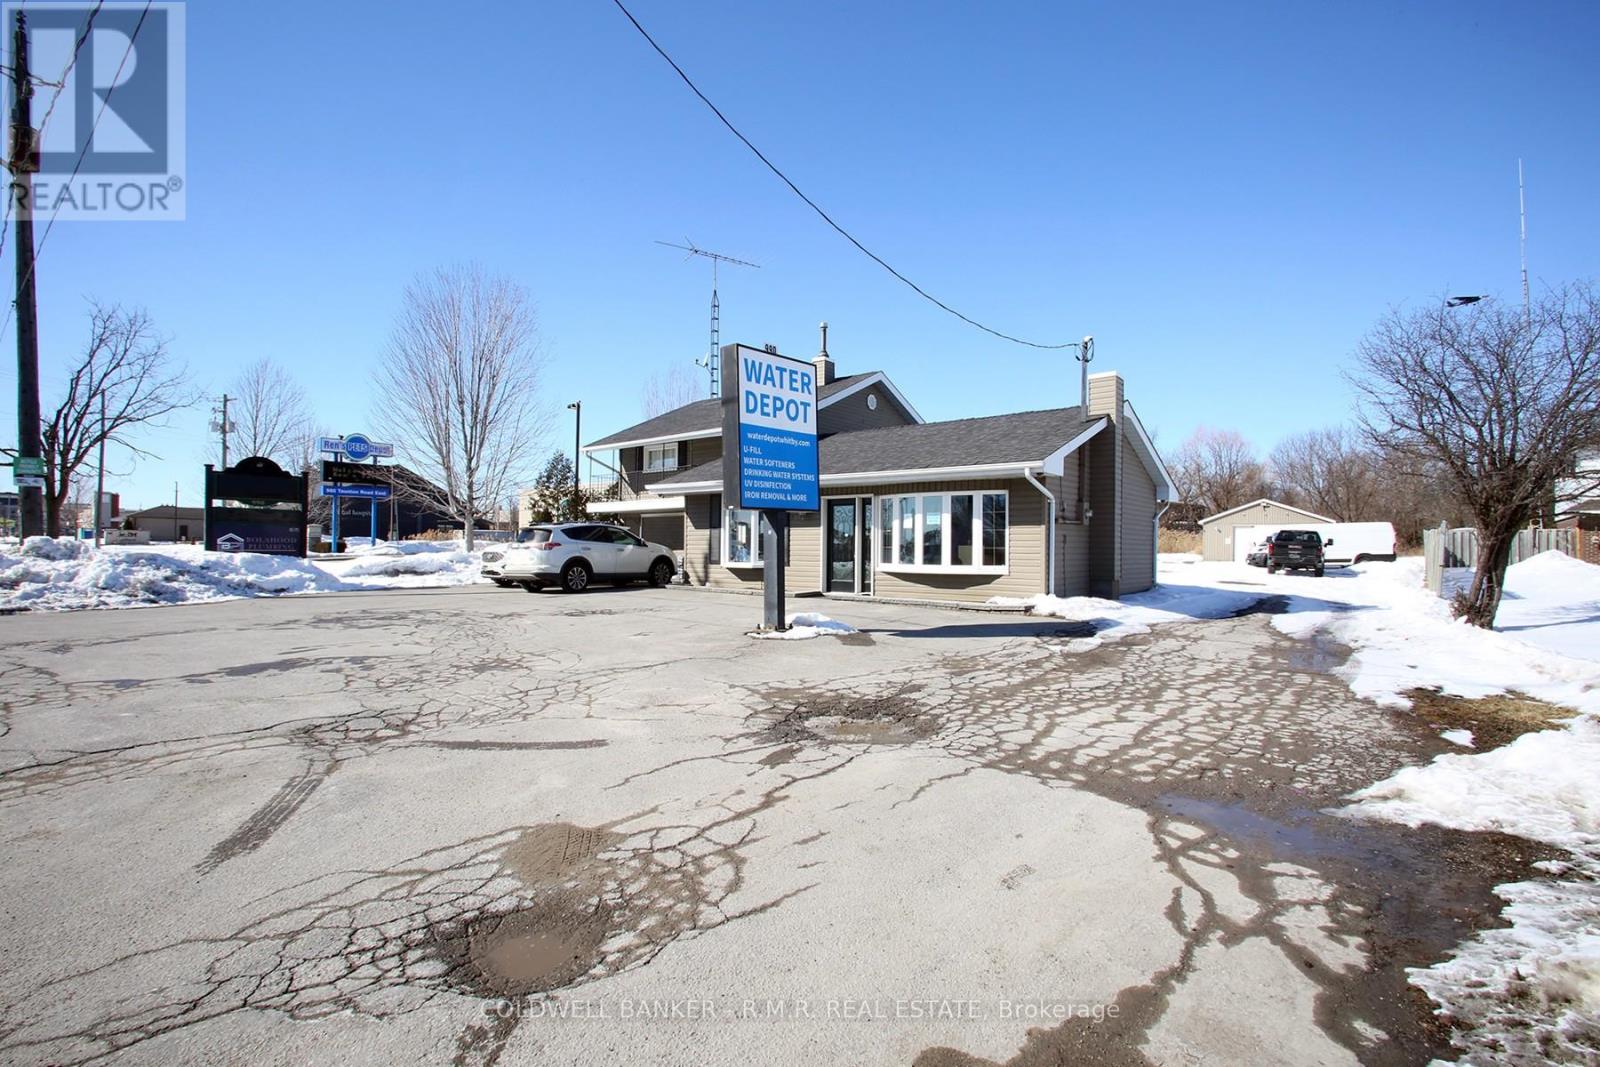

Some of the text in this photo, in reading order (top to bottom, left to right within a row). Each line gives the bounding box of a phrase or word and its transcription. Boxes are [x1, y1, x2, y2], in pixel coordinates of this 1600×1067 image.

[744, 358, 812, 395] WATER
[745, 390, 811, 423] DEPOT
[747, 432, 811, 447] waterdepotwhitby.com
[743, 445, 762, 455] U-FILL
[743, 456, 796, 469] WATER SOFTENERS
[744, 468, 815, 482] DRINKING WATER SYSTEMS
[744, 479, 792, 490] UV DISINFECTION
[744, 490, 760, 499] IRON
[760, 491, 786, 501] REMOVAL
[791, 493, 808, 502] MORE
